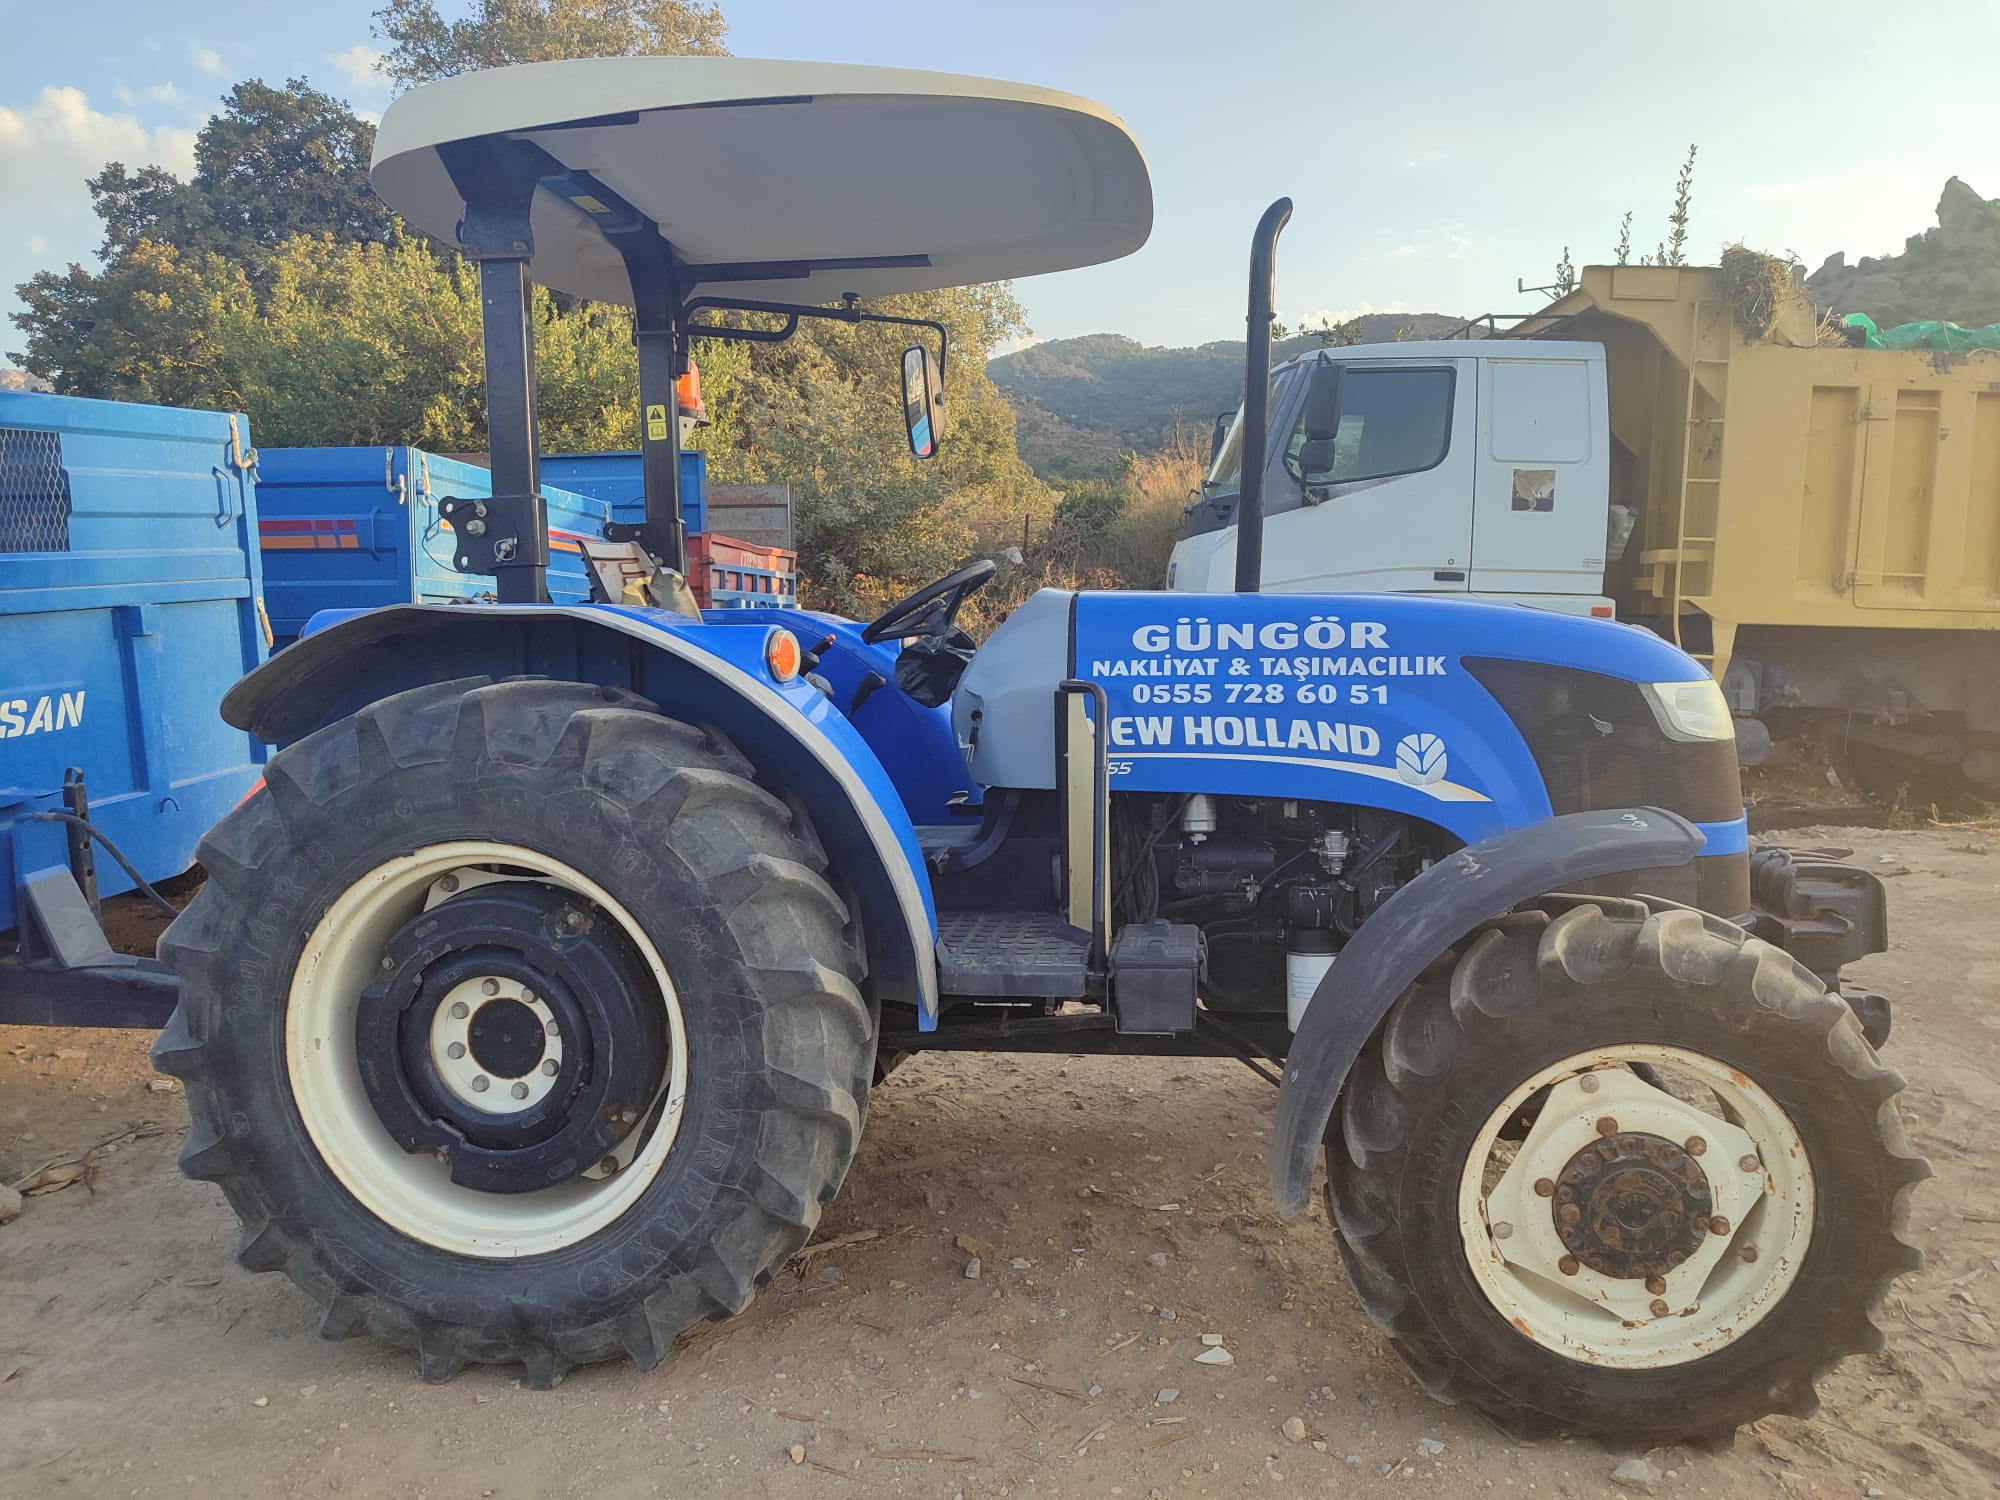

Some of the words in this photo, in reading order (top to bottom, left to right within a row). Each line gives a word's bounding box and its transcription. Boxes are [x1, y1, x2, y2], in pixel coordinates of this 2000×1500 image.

[1132, 616, 1390, 652] GÜNGÖR
[1092, 653, 1219, 677] NAKLİYAT
[1228, 657, 1251, 676] &
[1259, 655, 1447, 681] TAŞIMACILIK
[1132, 683, 1212, 704] 0555
[1224, 683, 1285, 704] 728
[1296, 683, 1337, 704] 60
[1350, 684, 1388, 704] 51
[1184, 716, 1380, 756] HOLLAND
